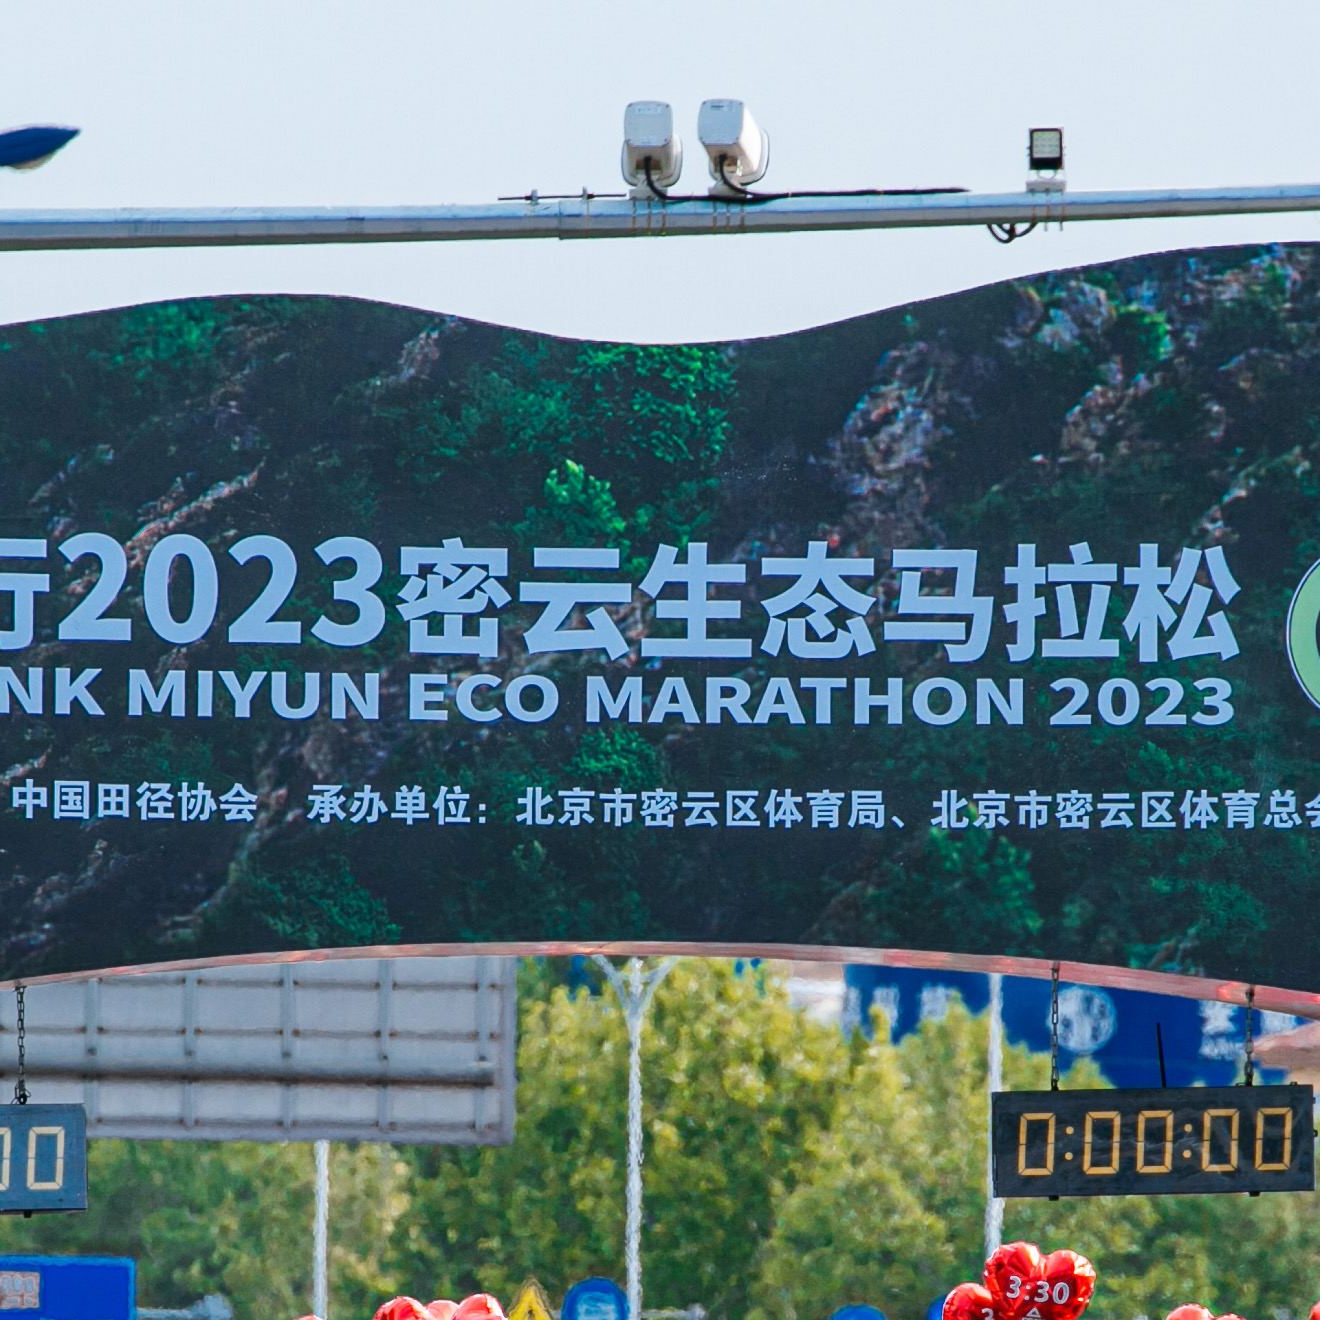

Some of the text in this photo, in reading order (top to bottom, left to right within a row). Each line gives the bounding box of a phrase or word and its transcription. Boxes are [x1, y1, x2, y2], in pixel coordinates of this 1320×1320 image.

[126, 666, 382, 721] MIYUN
[408, 671, 561, 723] ECO
[586, 674, 1025, 728] MARATHON
[1046, 676, 1236, 728] 2023
[1017, 1106, 1293, 1177] 0:00:00
[1006, 1275, 1070, 1304] 3:30
